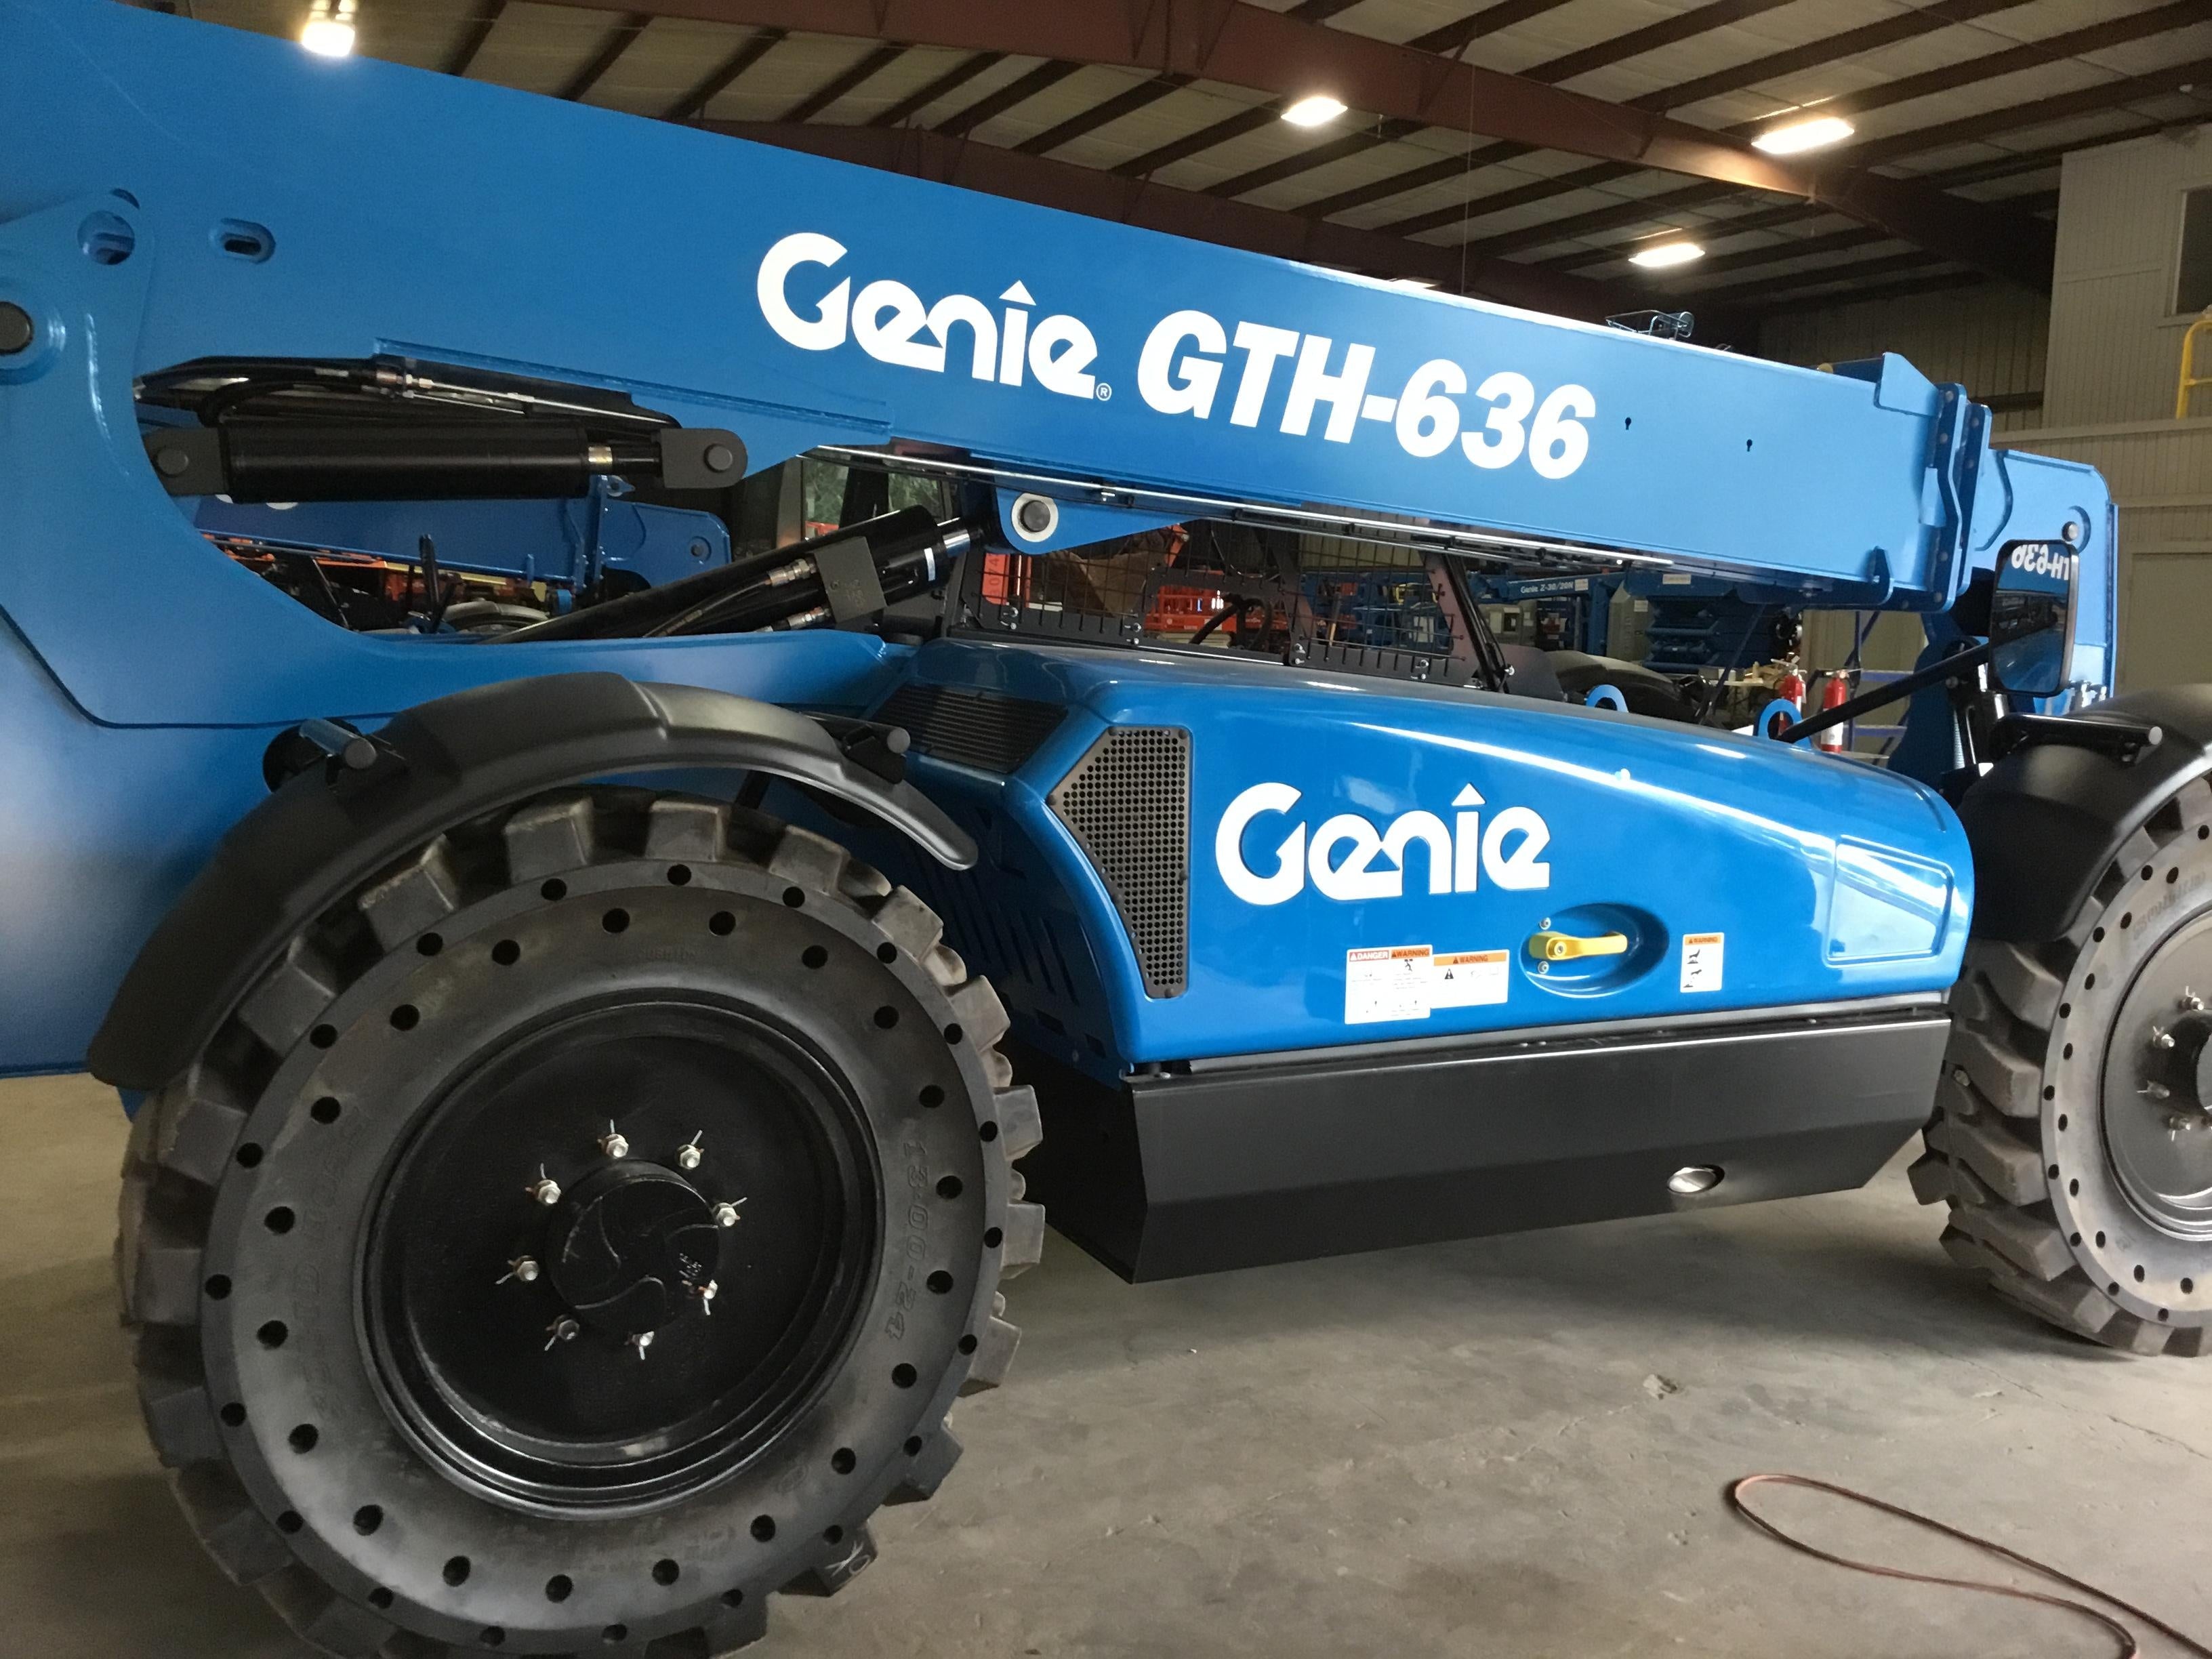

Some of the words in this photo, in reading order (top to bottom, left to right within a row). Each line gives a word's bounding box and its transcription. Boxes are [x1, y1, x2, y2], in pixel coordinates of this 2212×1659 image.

[757, 232, 1098, 399] Genie
[1137, 310, 1596, 479] GTH-636
[1216, 783, 1551, 905] Genie
[1357, 951, 1389, 961] DANGER
[1396, 948, 1429, 958] WARNING
[1460, 954, 1488, 964] WARNING
